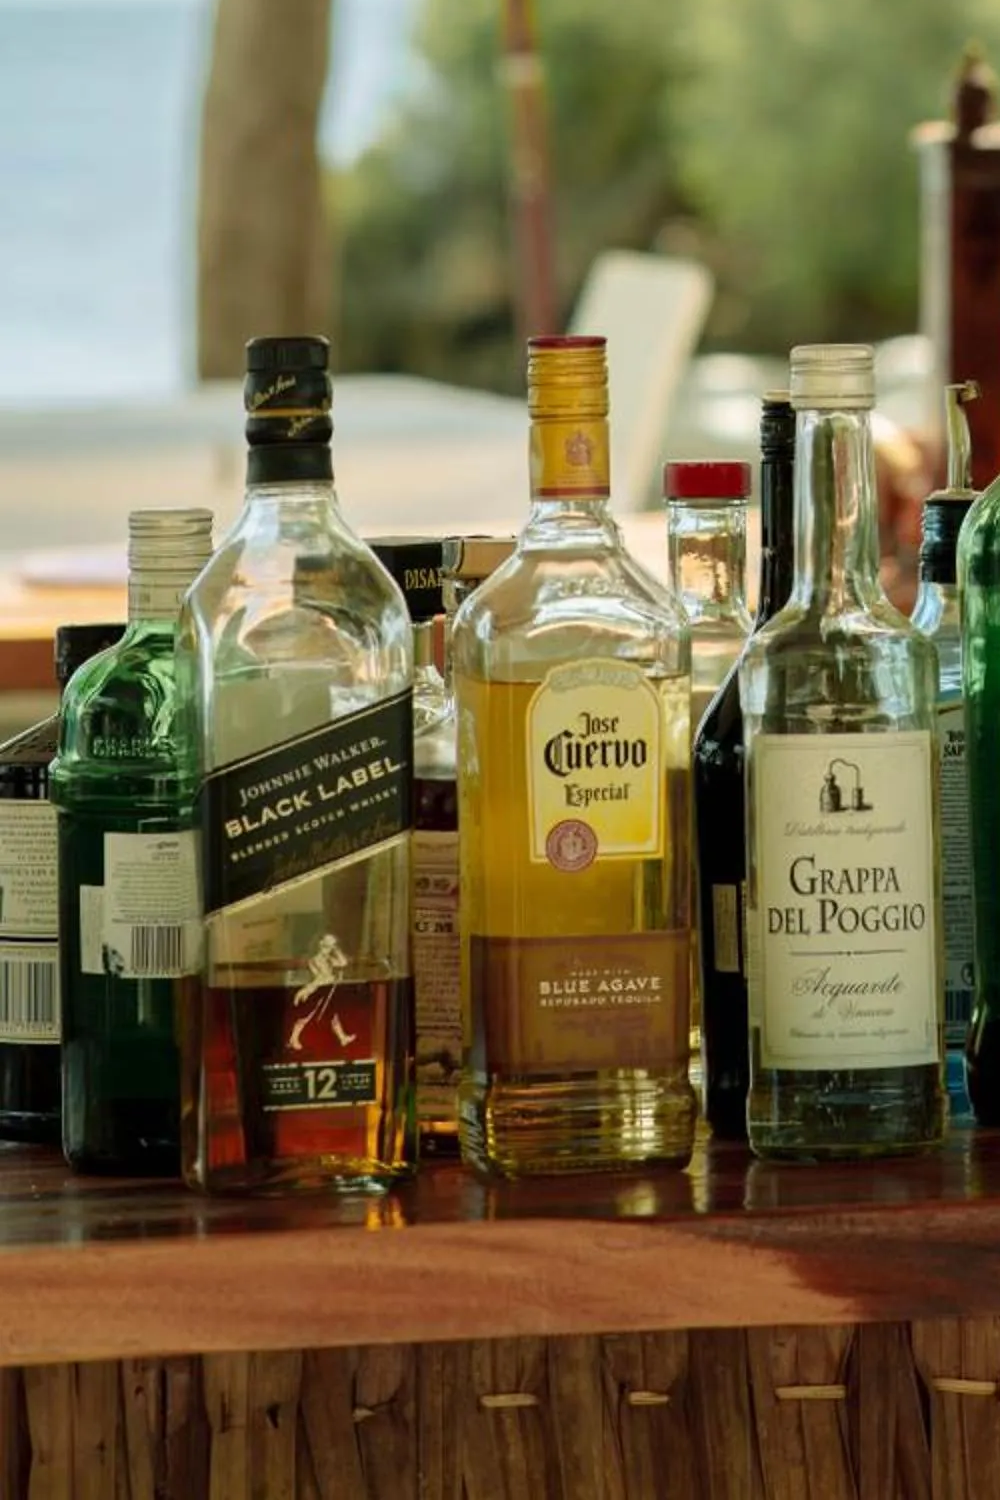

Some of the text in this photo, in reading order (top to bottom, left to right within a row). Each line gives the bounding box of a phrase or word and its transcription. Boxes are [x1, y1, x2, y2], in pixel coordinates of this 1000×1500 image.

[544, 729, 648, 778] Cuervo
[224, 755, 401, 839] BLACK LABEL
[239, 763, 313, 807] JOHNNIE
[563, 782, 632, 808] Especial
[789, 853, 901, 897] GRAPPA
[768, 899, 926, 936] DEL POGGIO
[540, 976, 662, 995] BLUE AGAVE
[304, 1068, 338, 1099] 12
